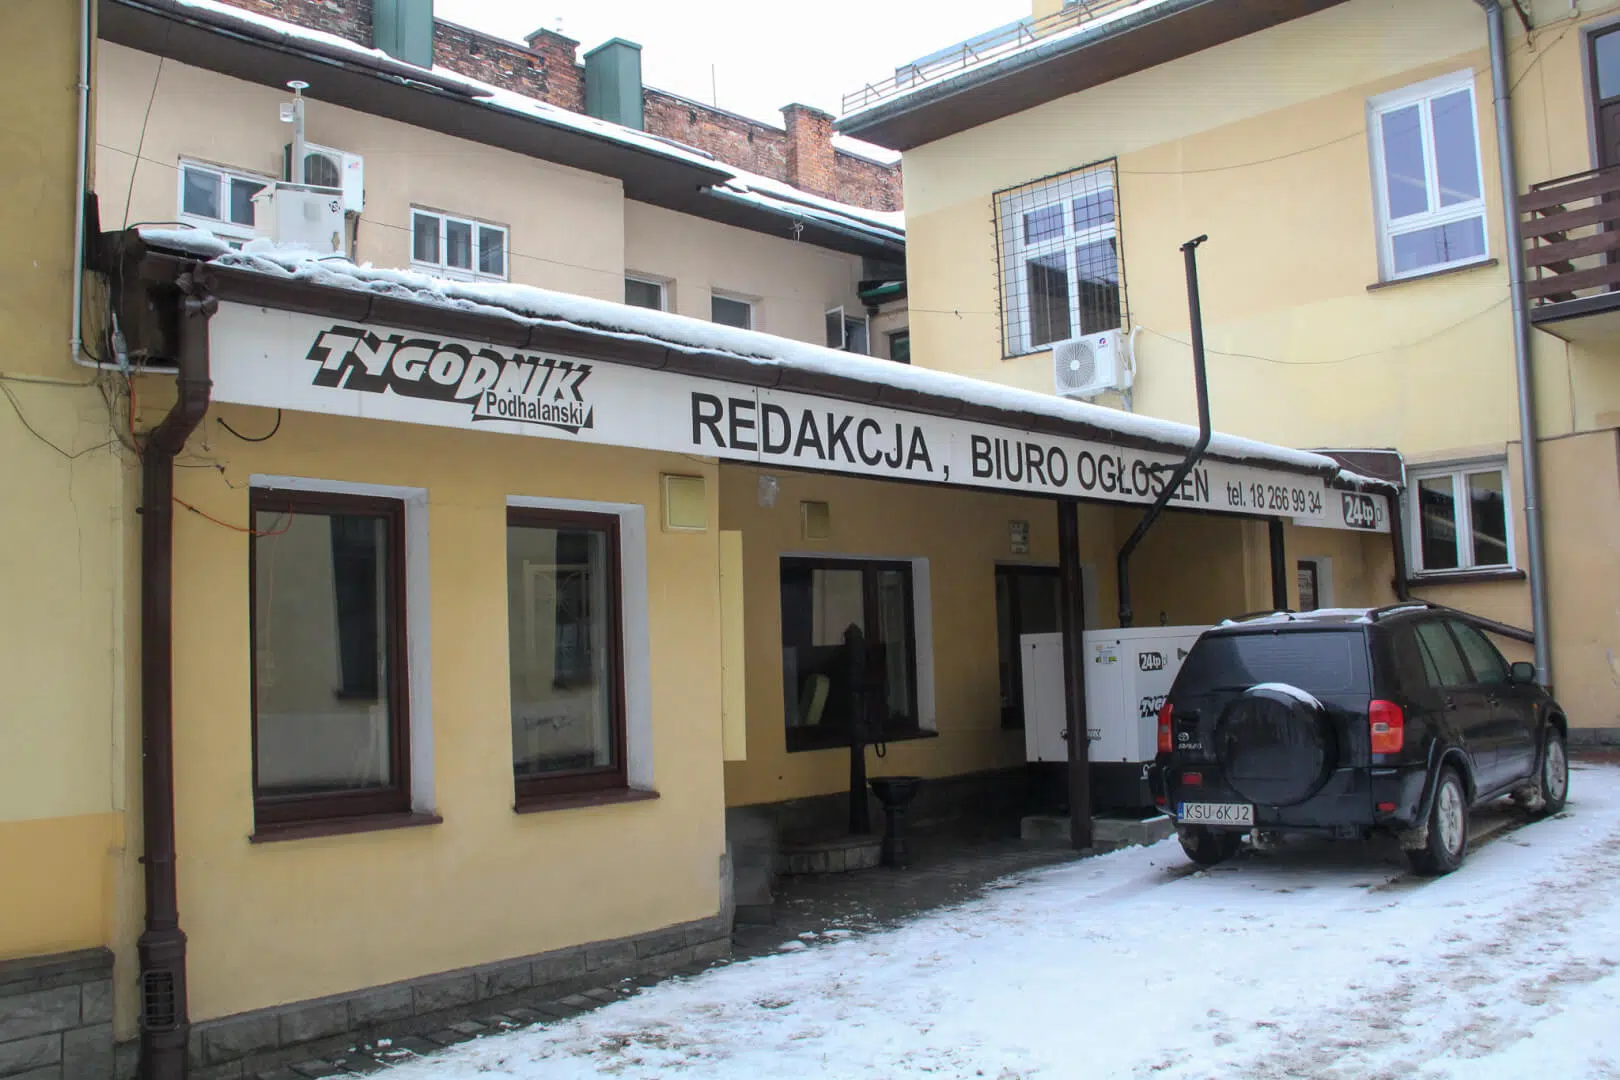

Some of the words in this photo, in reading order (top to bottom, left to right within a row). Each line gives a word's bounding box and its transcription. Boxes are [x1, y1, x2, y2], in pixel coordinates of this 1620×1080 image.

[306, 325, 593, 402] TYGODNIK
[970, 434, 1068, 488] BIURO
[1226, 481, 1246, 507] tel.
[1250, 483, 1265, 508] 18
[1268, 485, 1290, 511] 266
[1292, 488, 1306, 513] 99
[1308, 490, 1322, 514] 34
[1186, 805, 1212, 819] KSU
[1215, 805, 1249, 821] 6KJ2
